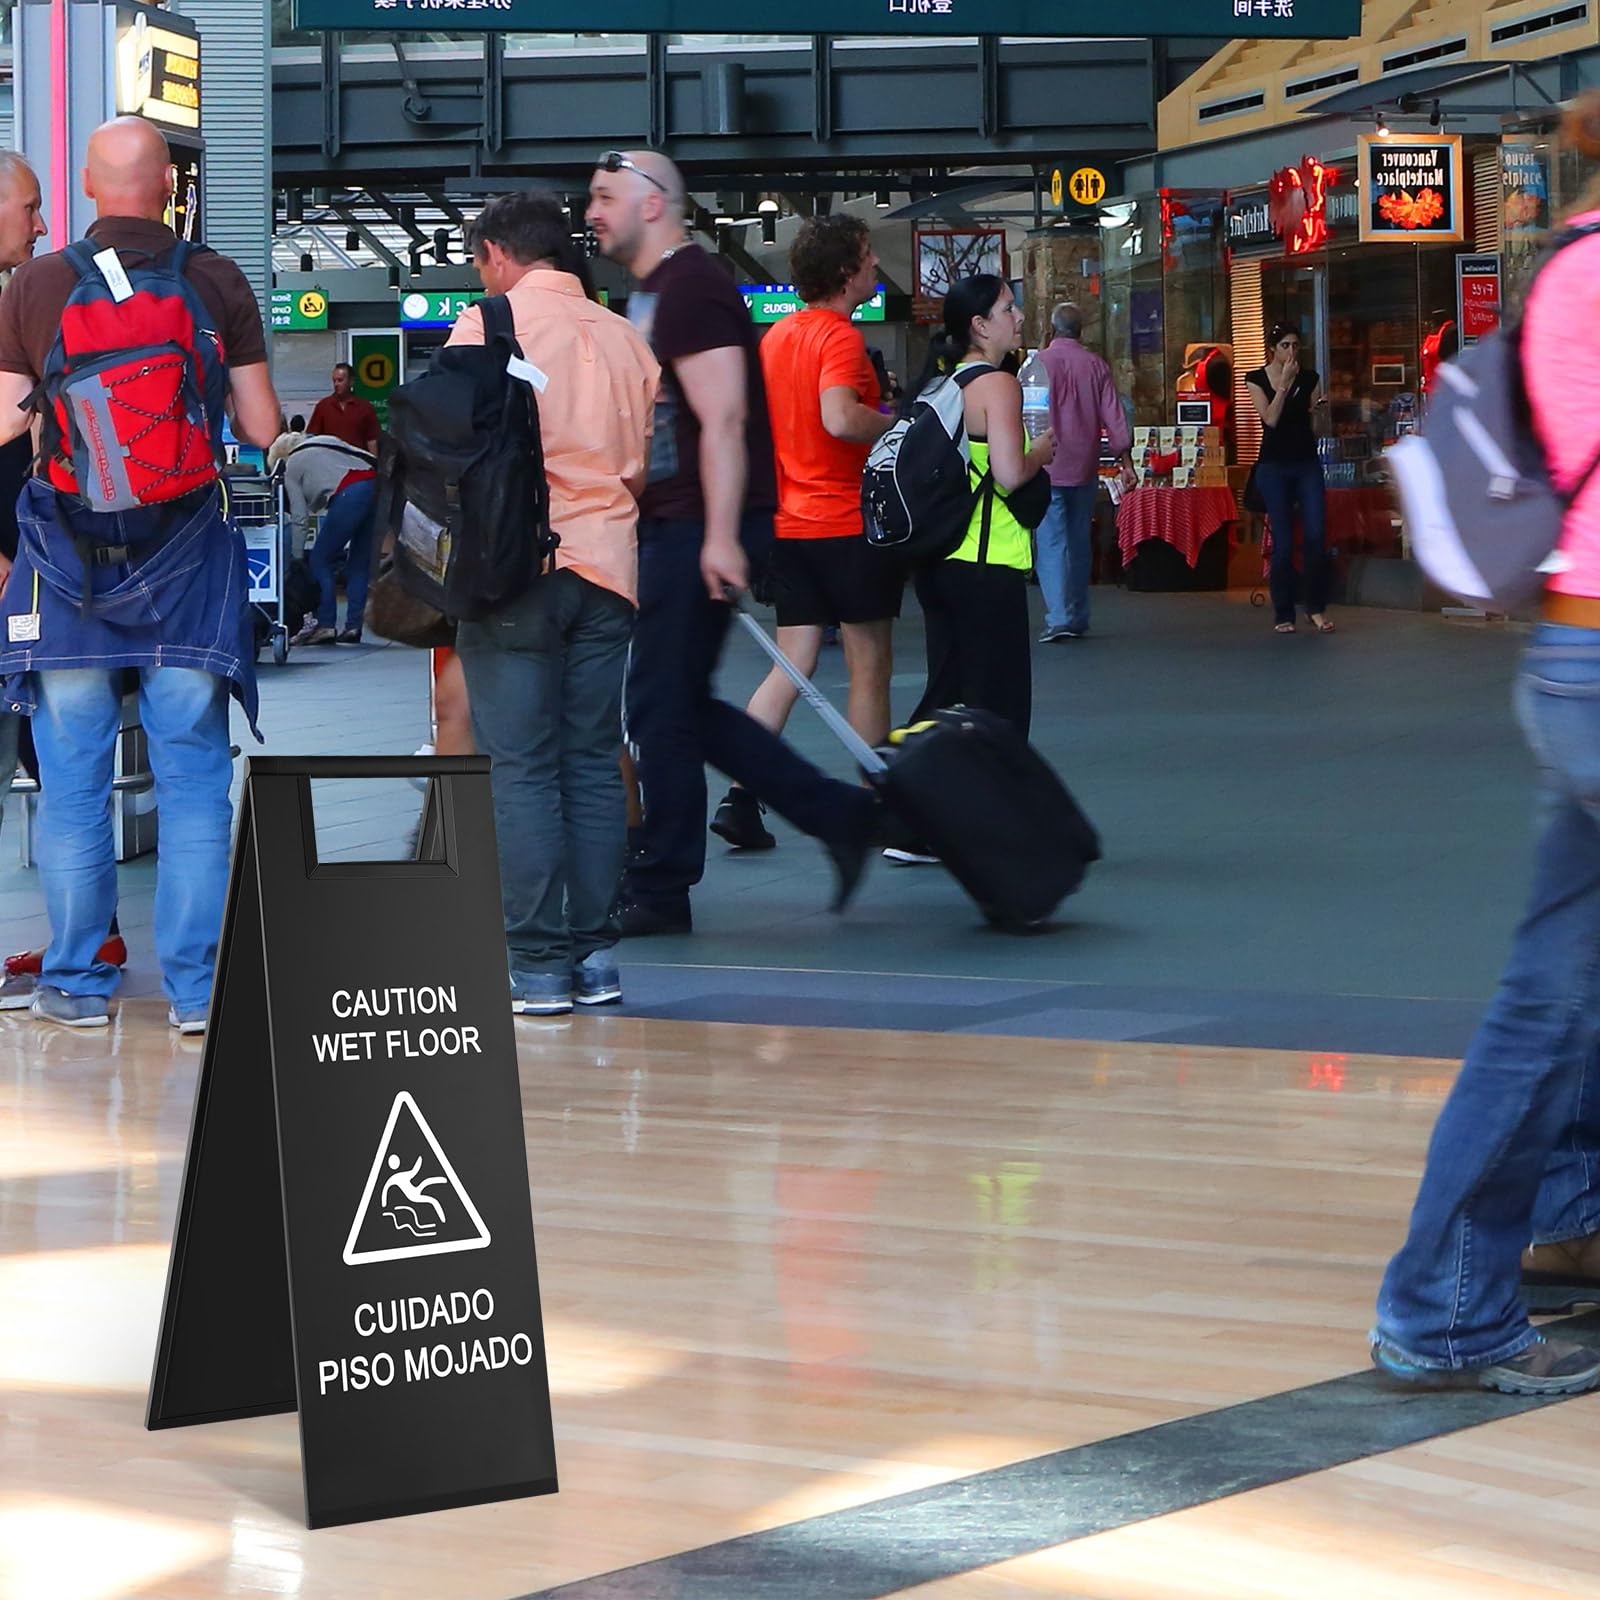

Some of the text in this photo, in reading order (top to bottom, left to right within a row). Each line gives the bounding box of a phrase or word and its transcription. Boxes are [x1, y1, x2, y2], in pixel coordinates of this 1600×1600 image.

[331, 985, 457, 1019] CAUTION
[311, 1026, 483, 1063] WET FLOOR
[354, 1288, 495, 1337] CUIDADO
[318, 1332, 533, 1396] PISO MOJADO
